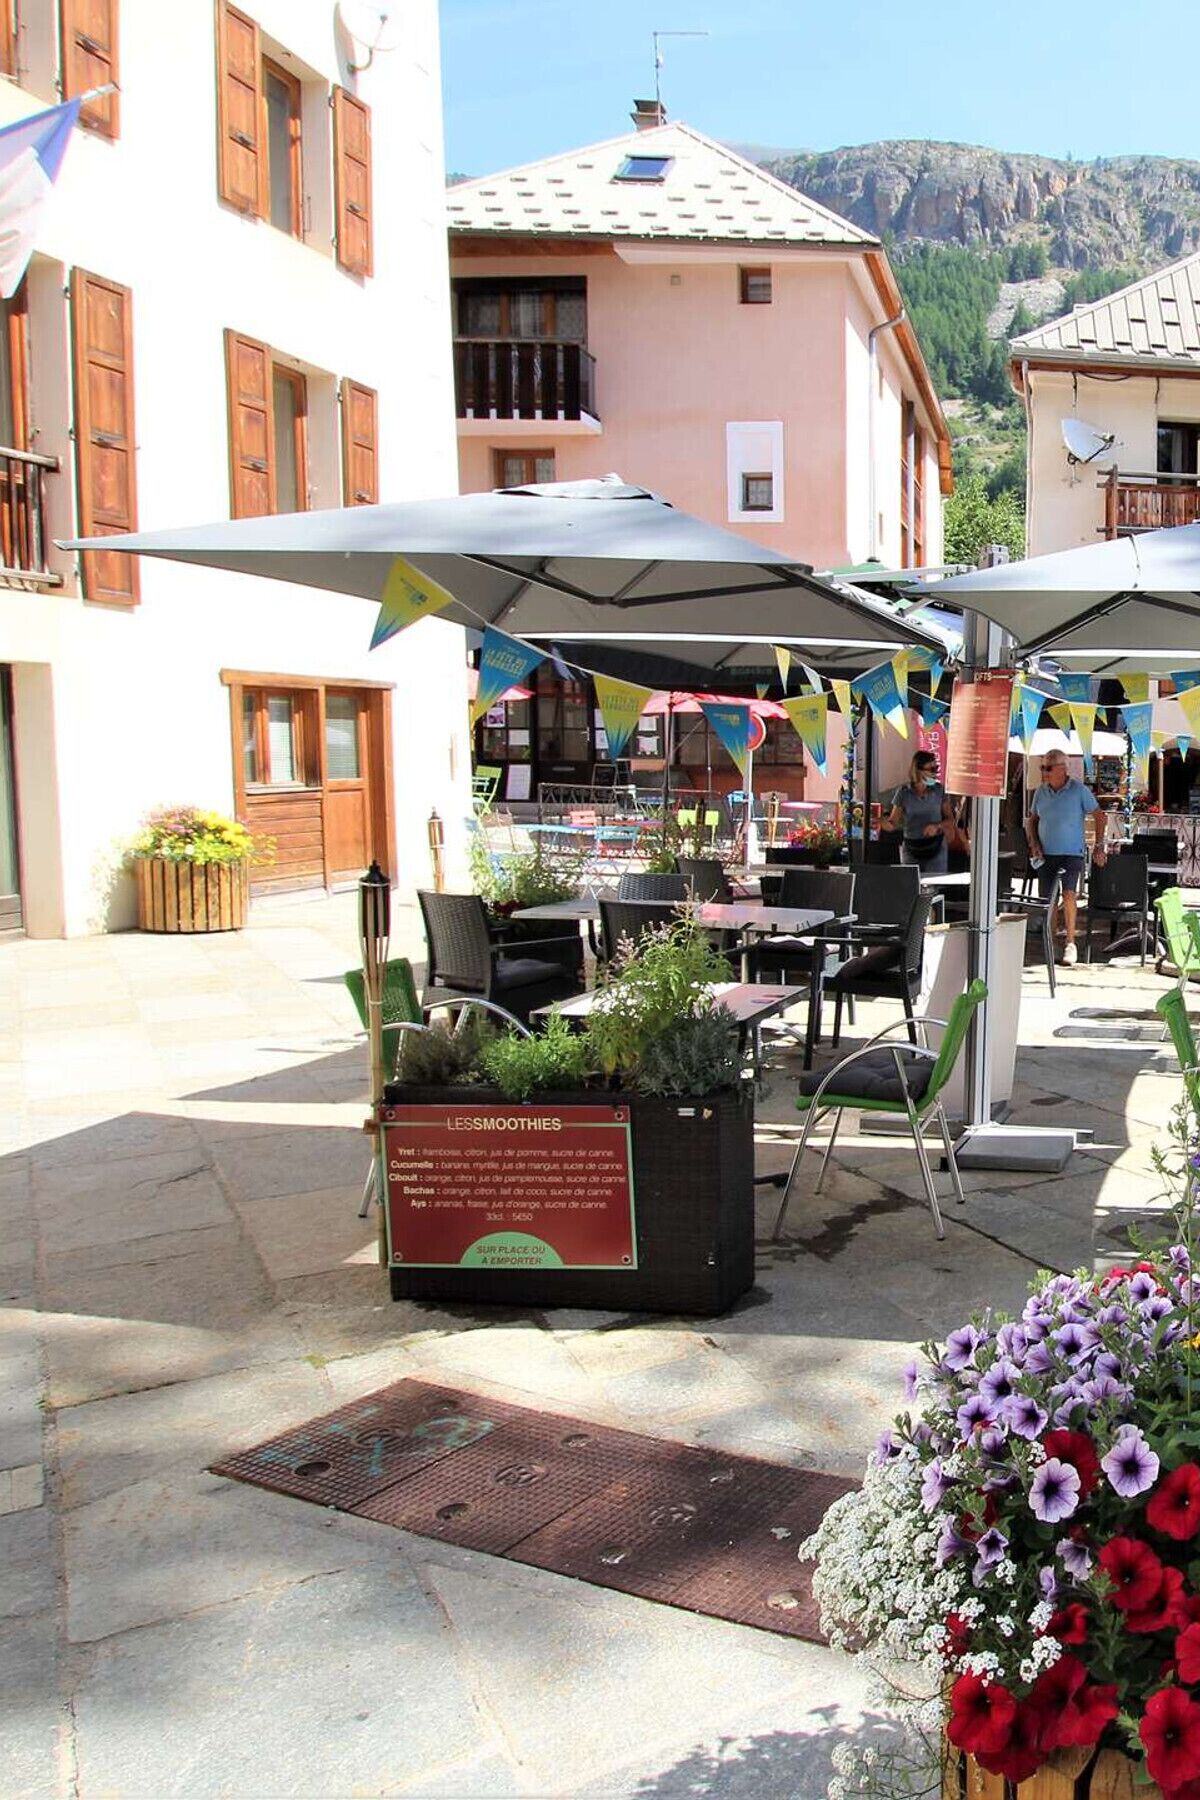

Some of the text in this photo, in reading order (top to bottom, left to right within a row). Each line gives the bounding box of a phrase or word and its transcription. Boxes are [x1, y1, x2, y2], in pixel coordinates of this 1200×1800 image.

[490, 1149, 503, 1159] jus
[503, 1149, 516, 1157] de
[551, 1150, 574, 1158] sucre
[575, 1149, 587, 1158] de
[501, 1162, 514, 1171] jus
[515, 1162, 526, 1170] de
[585, 1162, 596, 1170] de
[478, 1174, 491, 1184] jus
[491, 1174, 503, 1182] de
[565, 1175, 588, 1183] sucre
[588, 1175, 600, 1183] de
[512, 1187, 524, 1196] de
[549, 1188, 573, 1196] sucre
[574, 1188, 585, 1196] de
[490, 1200, 503, 1210] jus
[544, 1201, 567, 1209] sucre
[567, 1201, 579, 1209] de
[476, 1245, 497, 1255] SUR
[498, 1245, 529, 1255] PLACE
[490, 1256, 542, 1265] EMPORTER
